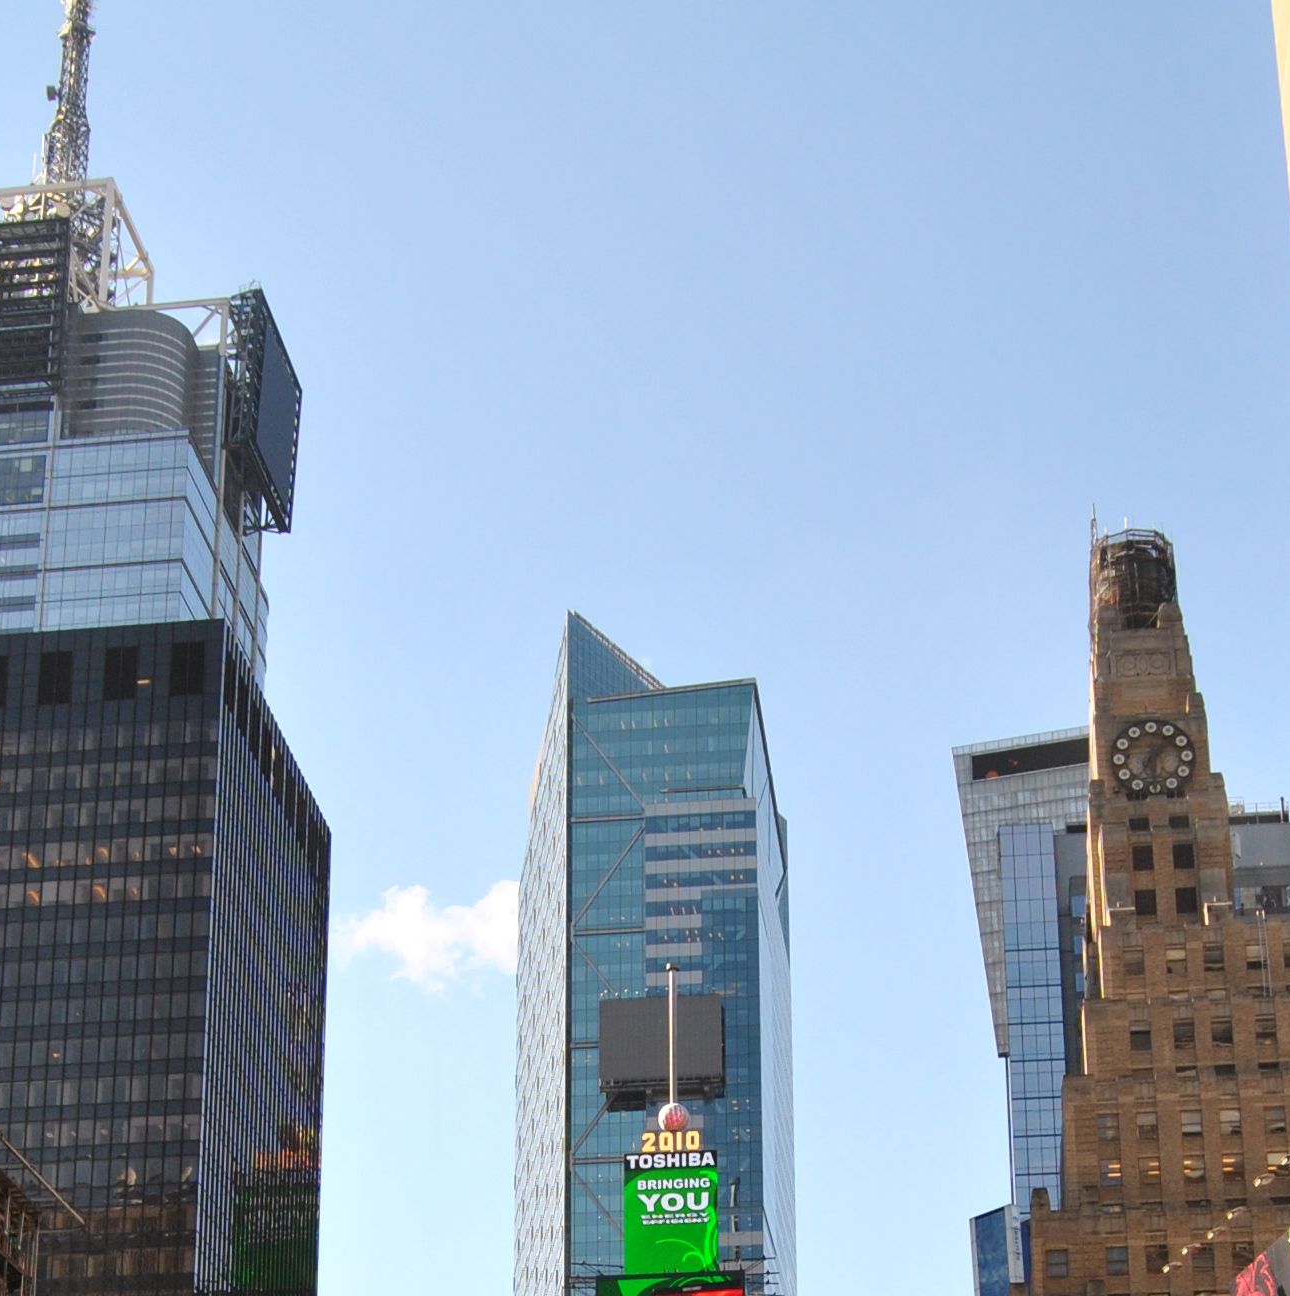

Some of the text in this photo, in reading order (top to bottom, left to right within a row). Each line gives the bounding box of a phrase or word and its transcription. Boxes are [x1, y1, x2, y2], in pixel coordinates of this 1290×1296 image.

[641, 1130, 701, 1153] 2010
[626, 1152, 716, 1170] TOSHIBA
[637, 1177, 711, 1191] BRINGING
[637, 1192, 710, 1212] YOU
